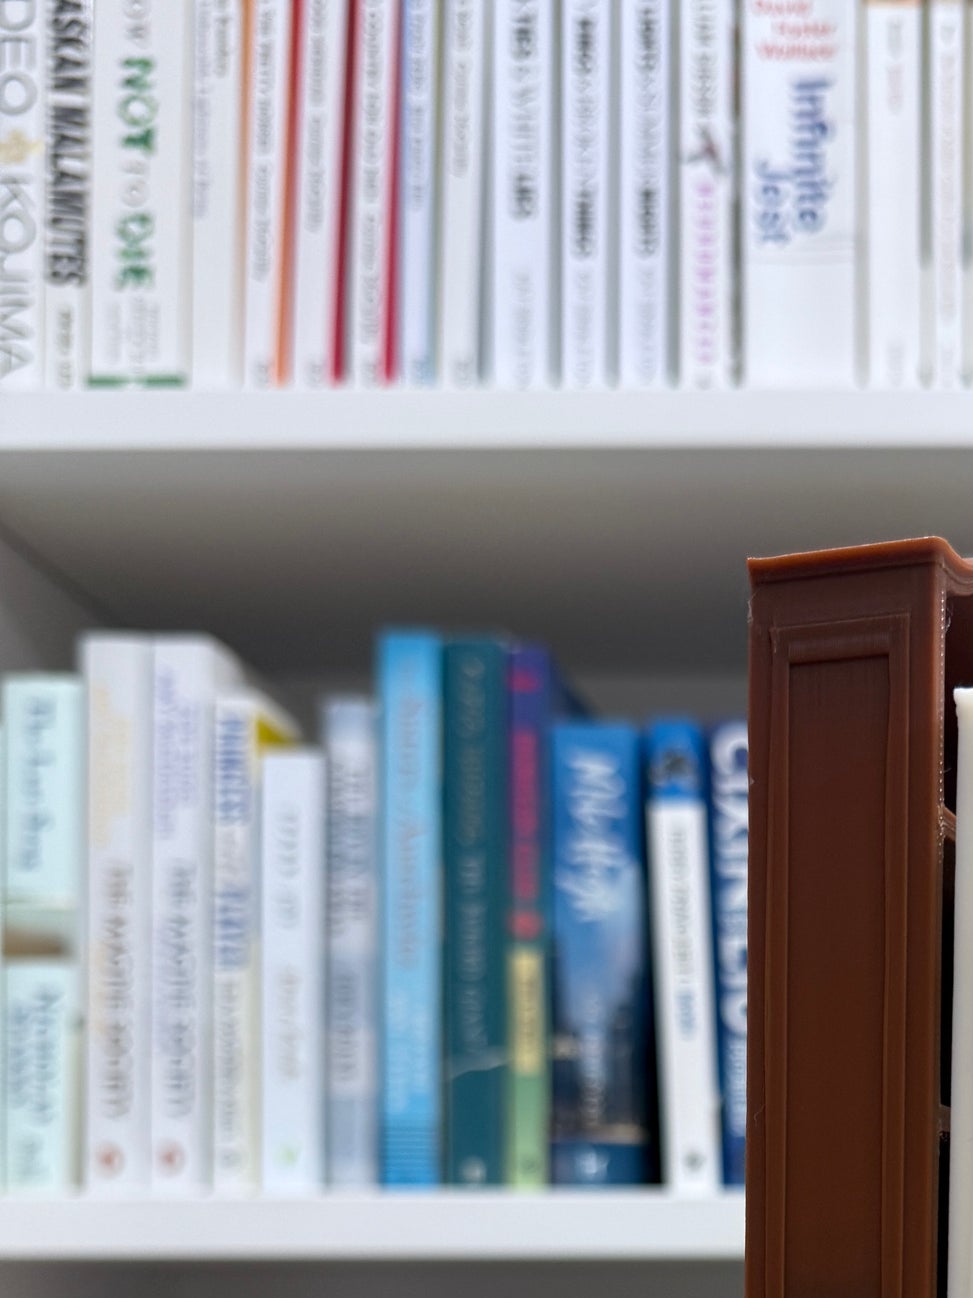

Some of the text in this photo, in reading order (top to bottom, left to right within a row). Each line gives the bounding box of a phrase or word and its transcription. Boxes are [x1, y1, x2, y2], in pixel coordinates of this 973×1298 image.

[118, 56, 156, 154] NOT
[44, 104, 86, 288] MALAMUTES
[754, 157, 792, 247] Jest
[791, 74, 836, 237] Infinite
[114, 211, 155, 292] DIE
